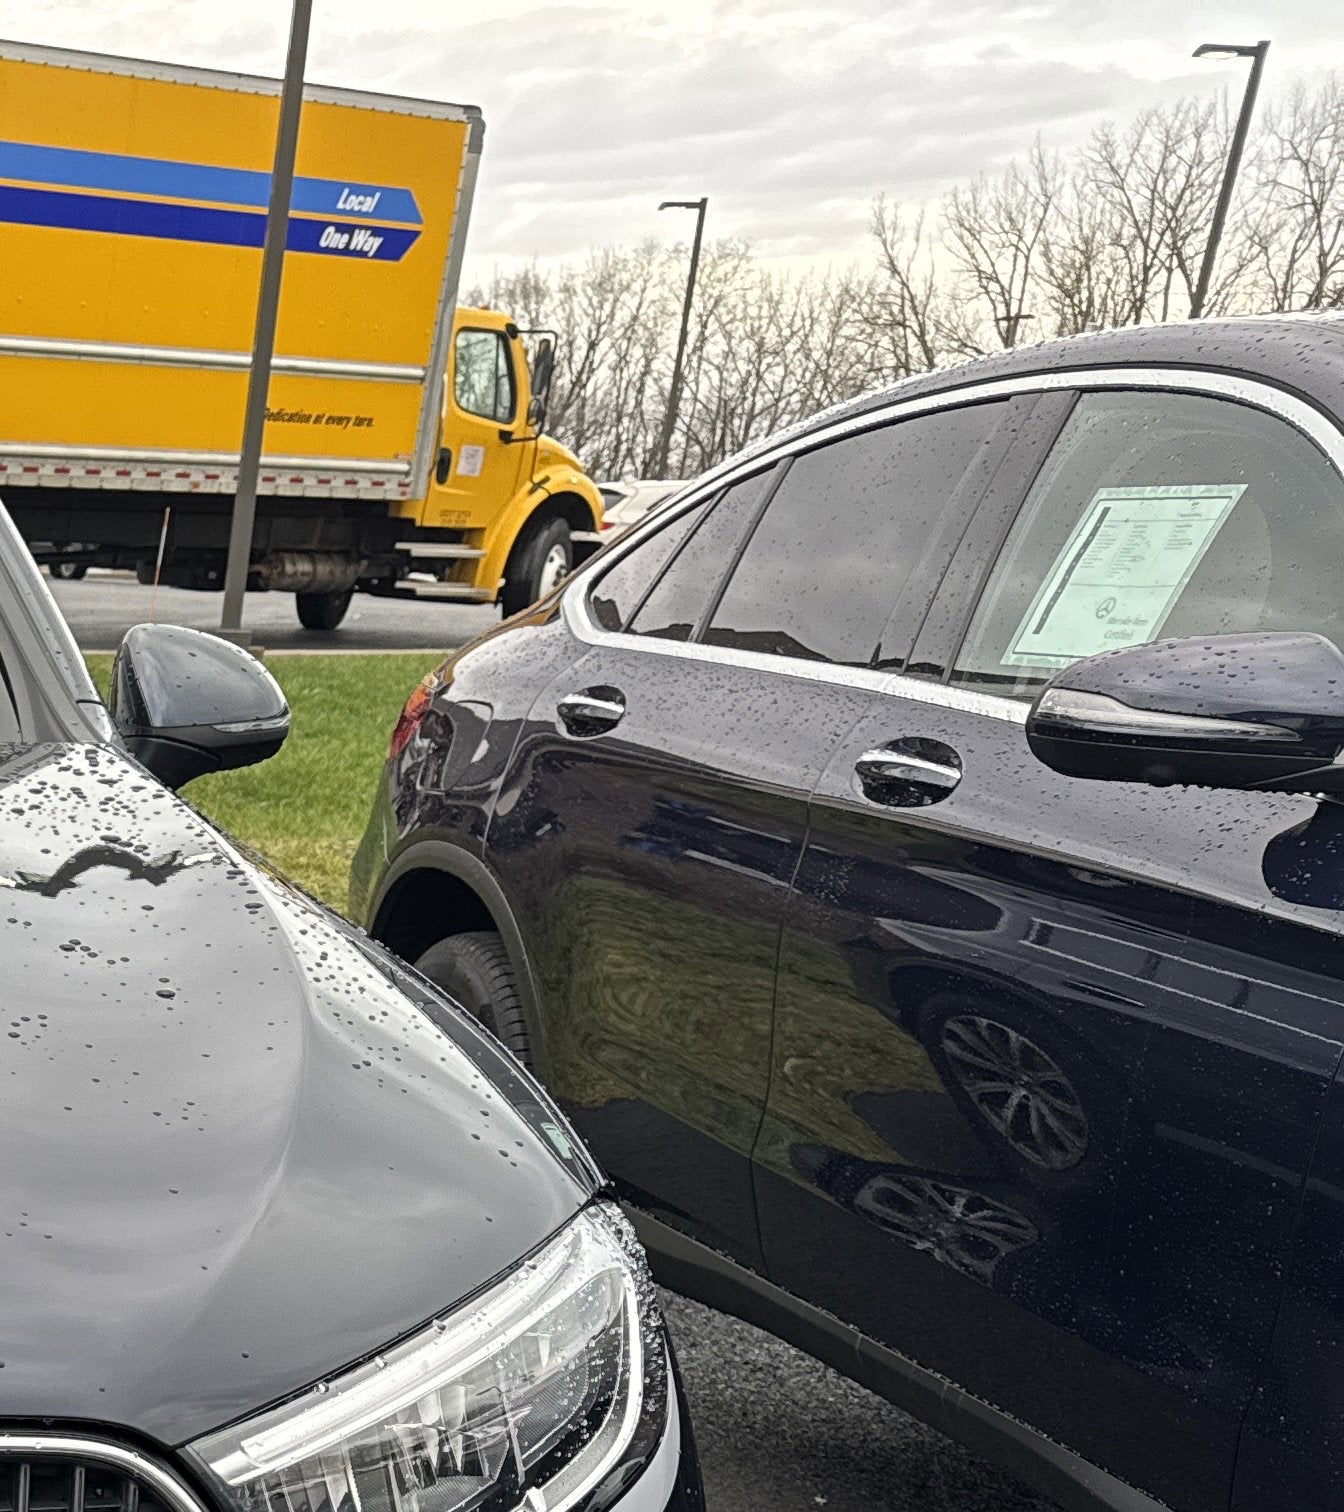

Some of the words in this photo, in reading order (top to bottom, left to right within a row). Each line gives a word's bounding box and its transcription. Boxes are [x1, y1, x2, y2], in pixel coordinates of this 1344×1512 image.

[337, 188, 382, 213] Local
[319, 226, 349, 249] One
[349, 229, 384, 257] Way
[325, 415, 352, 430] every
